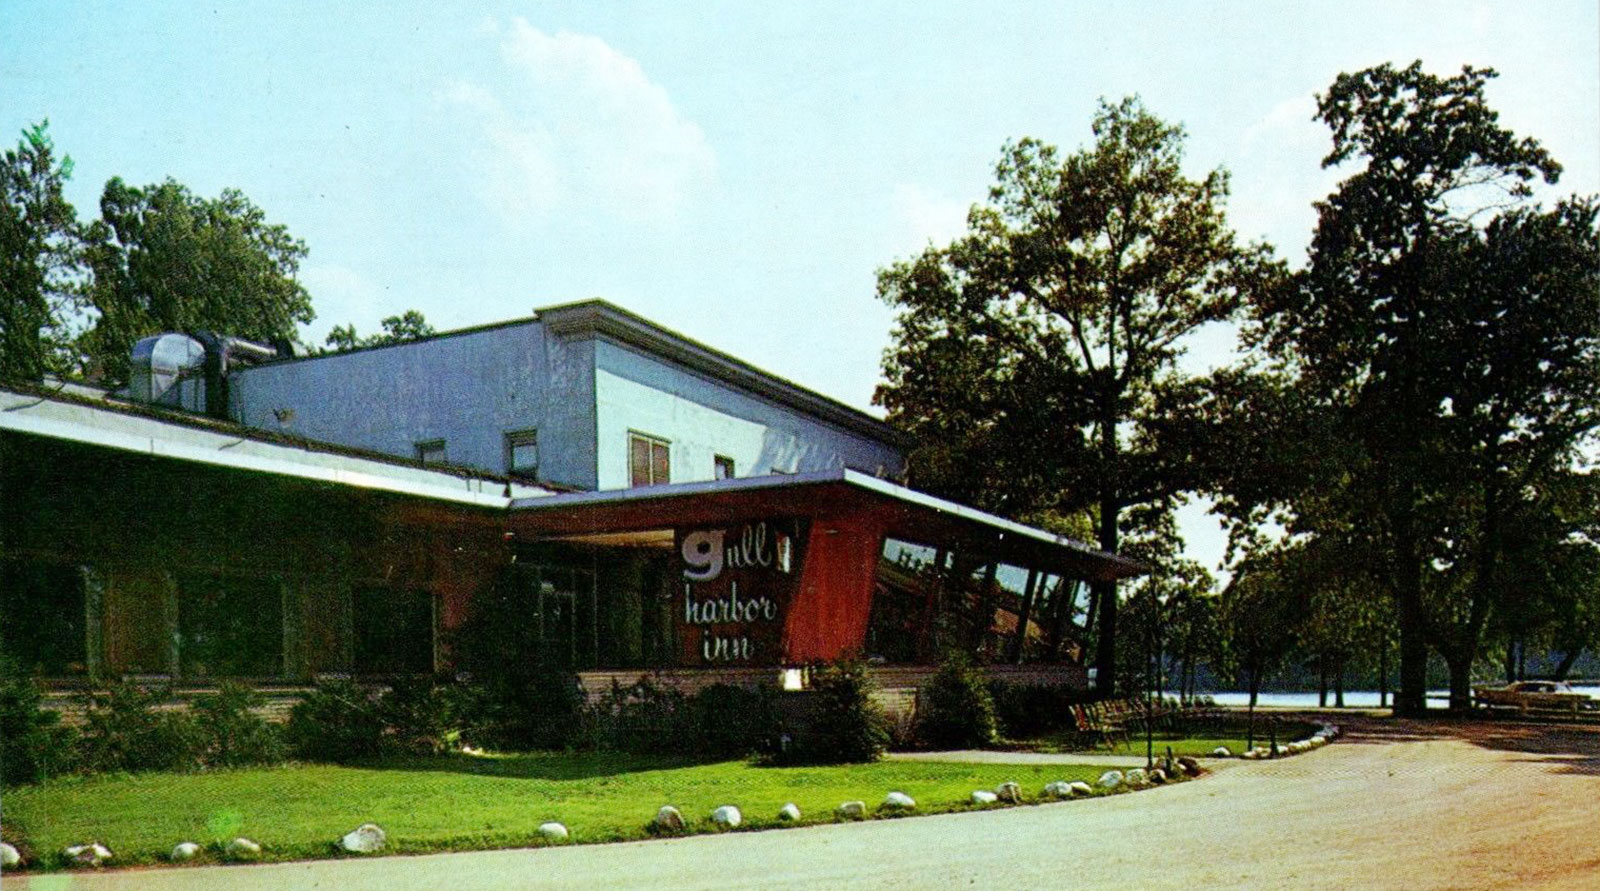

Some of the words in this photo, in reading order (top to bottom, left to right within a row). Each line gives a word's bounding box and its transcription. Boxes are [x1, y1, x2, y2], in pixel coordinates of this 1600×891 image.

[681, 521, 772, 582] gull
[685, 580, 777, 624] harbor
[703, 629, 755, 661] inn
